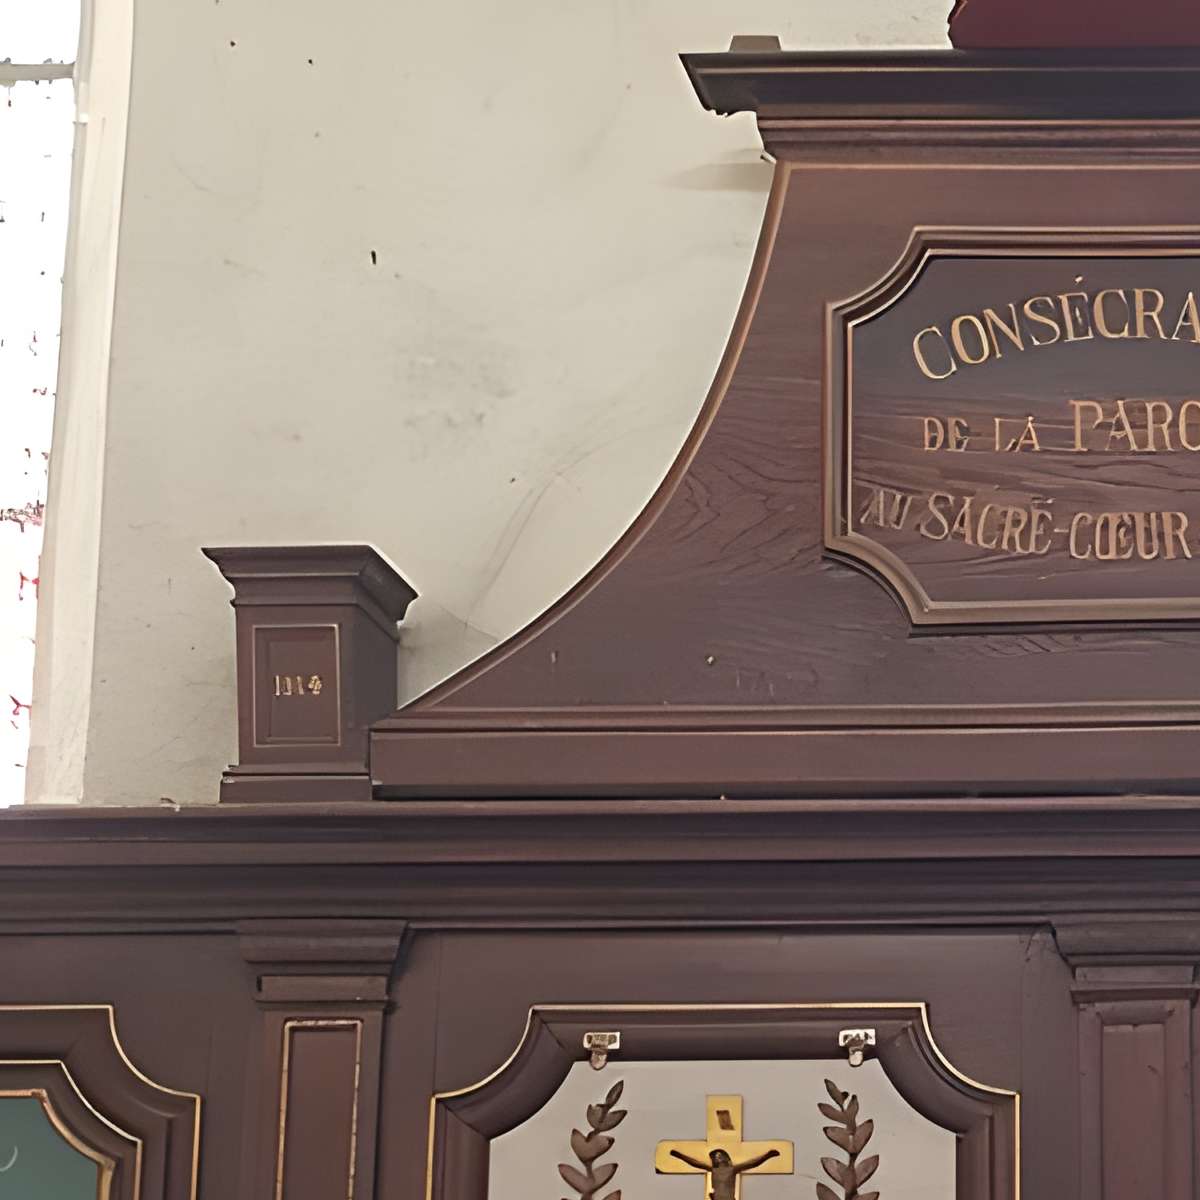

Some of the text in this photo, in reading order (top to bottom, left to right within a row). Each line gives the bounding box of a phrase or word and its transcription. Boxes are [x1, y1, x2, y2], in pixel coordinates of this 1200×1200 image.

[924, 417, 969, 450] DE
[995, 416, 1039, 452] LA
[860, 488, 911, 529] AU
